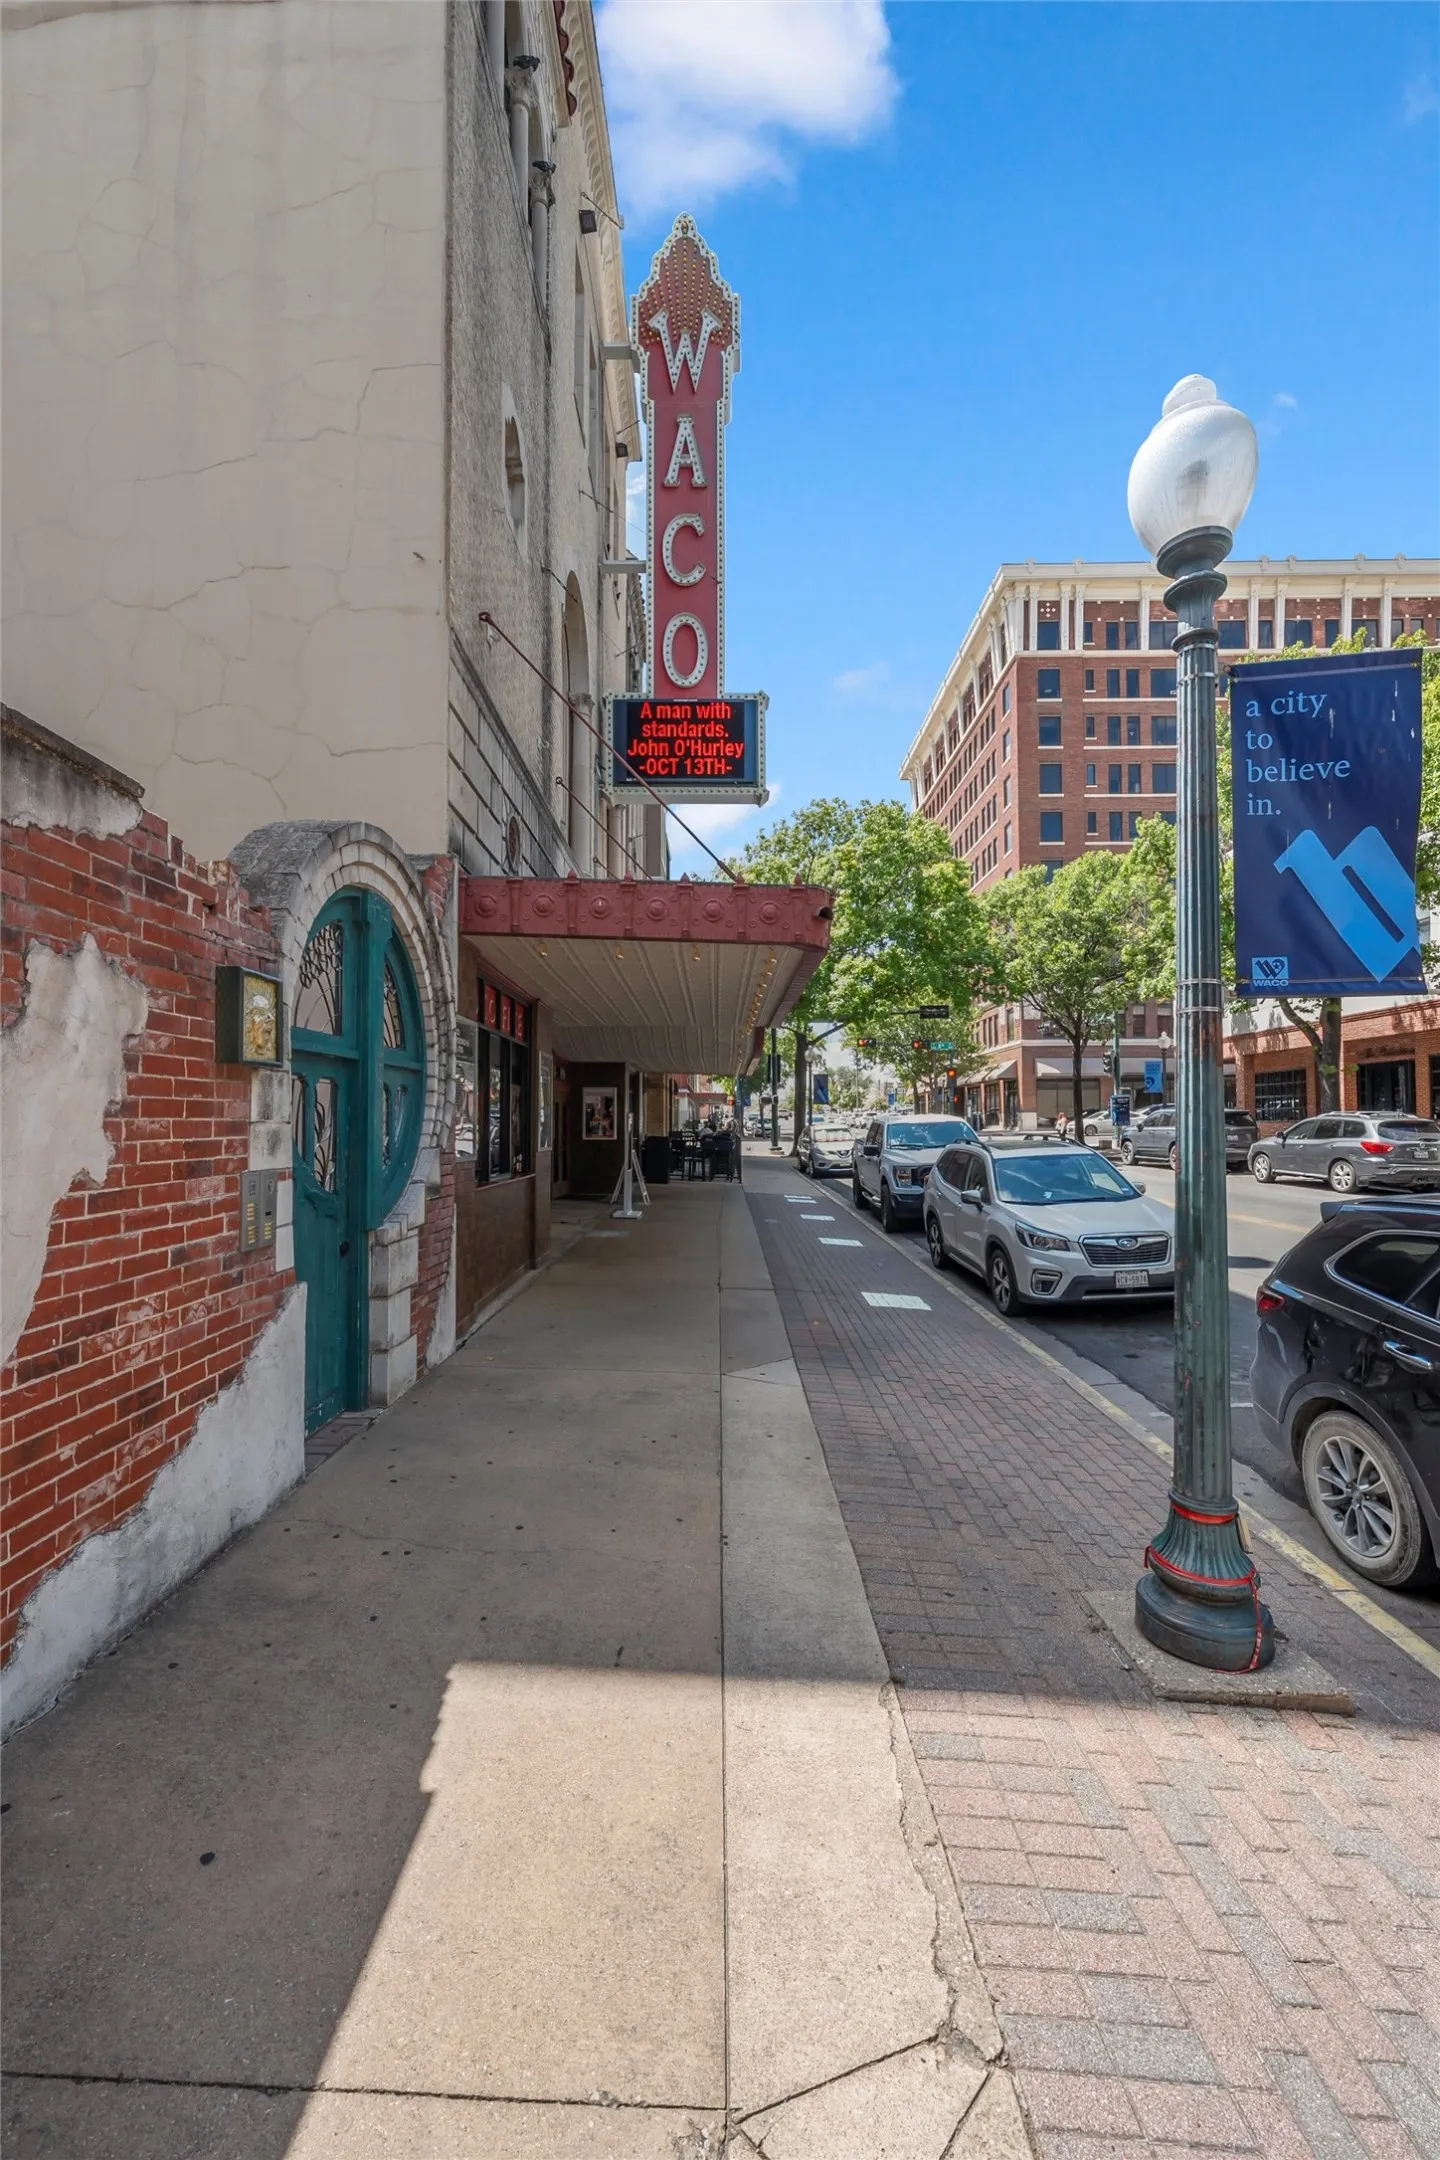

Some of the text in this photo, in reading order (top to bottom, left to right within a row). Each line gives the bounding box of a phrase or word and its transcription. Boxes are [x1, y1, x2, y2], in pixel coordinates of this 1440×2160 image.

[648, 307, 722, 689] WACO
[640, 702, 731, 719] A man with
[1246, 690, 1328, 719] a city
[642, 721, 729, 738] standards.
[1246, 729, 1273, 750] to
[627, 739, 744, 759] John O'Hurley
[639, 758, 733, 775] -OCT 13TH-
[1245, 758, 1351, 783] believe
[1247, 793, 1281, 816] in.
[1252, 979, 1289, 987] WACO
